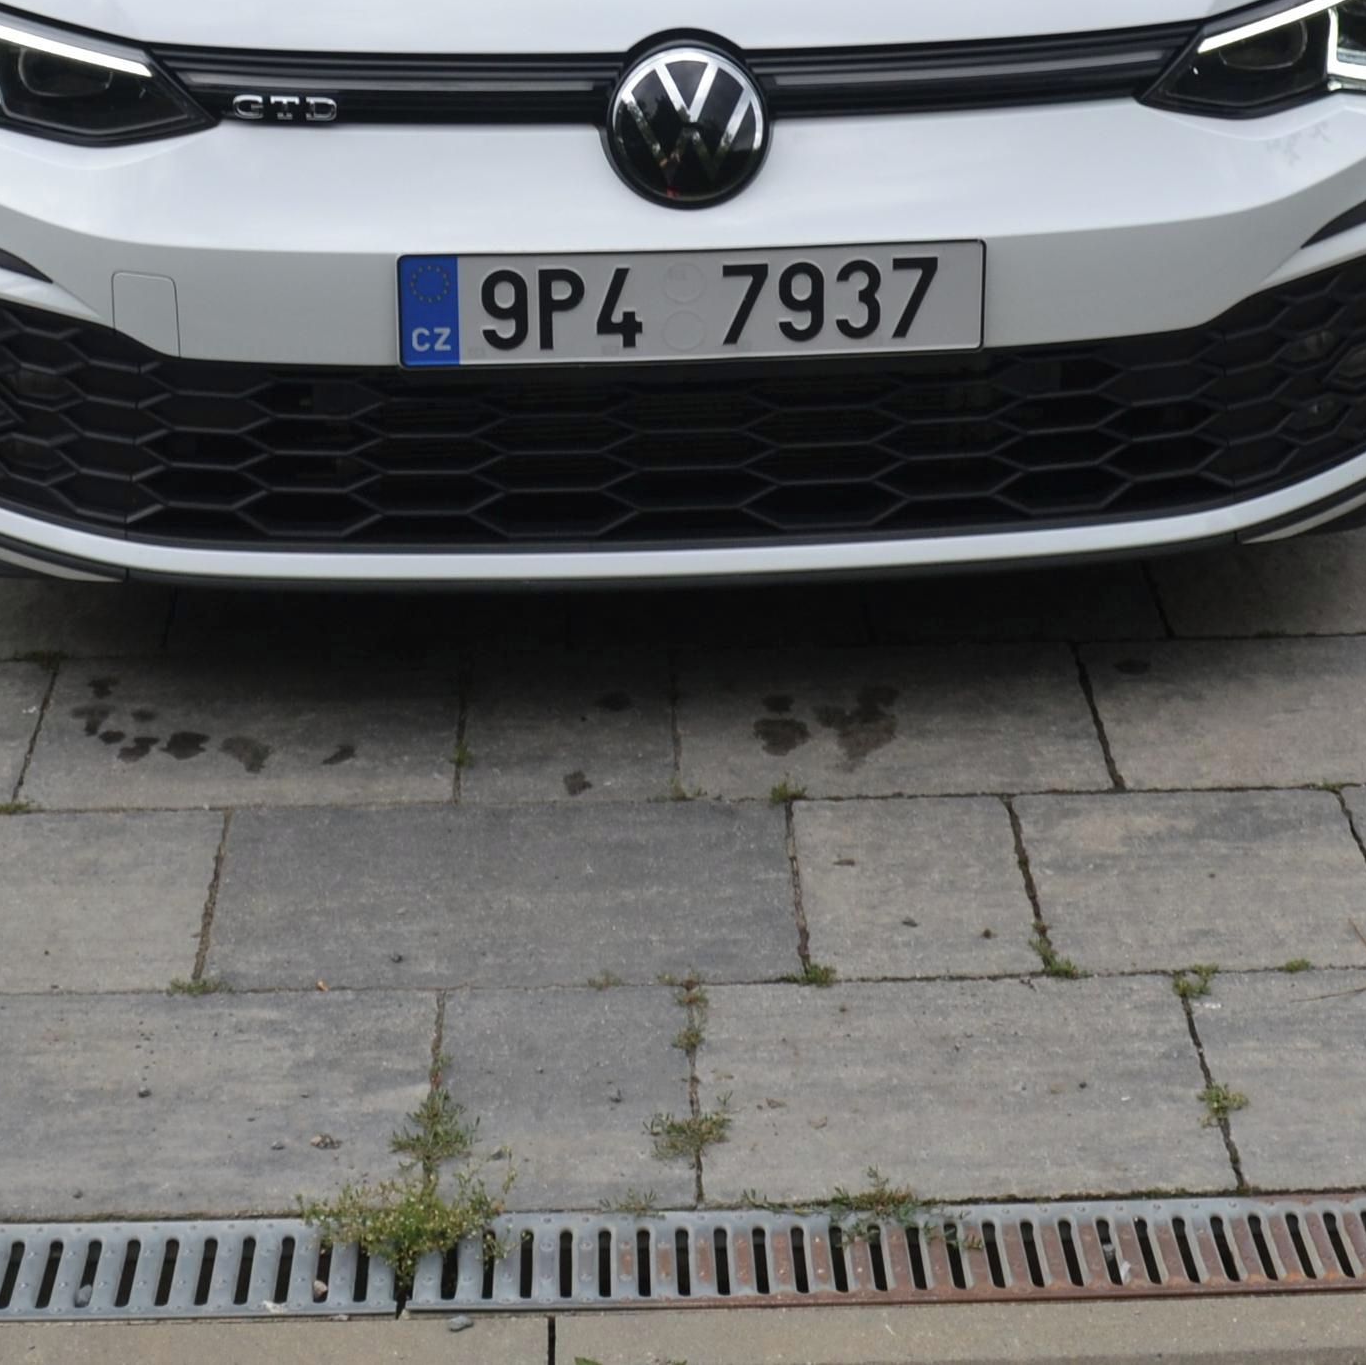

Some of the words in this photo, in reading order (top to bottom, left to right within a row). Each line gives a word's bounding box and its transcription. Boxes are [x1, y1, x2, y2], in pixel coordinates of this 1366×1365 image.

[233, 94, 337, 122] GTD
[616, 52, 758, 199] VW
[481, 268, 643, 351] 9P4
[722, 256, 939, 345] 7937
[411, 327, 452, 352] CZ
